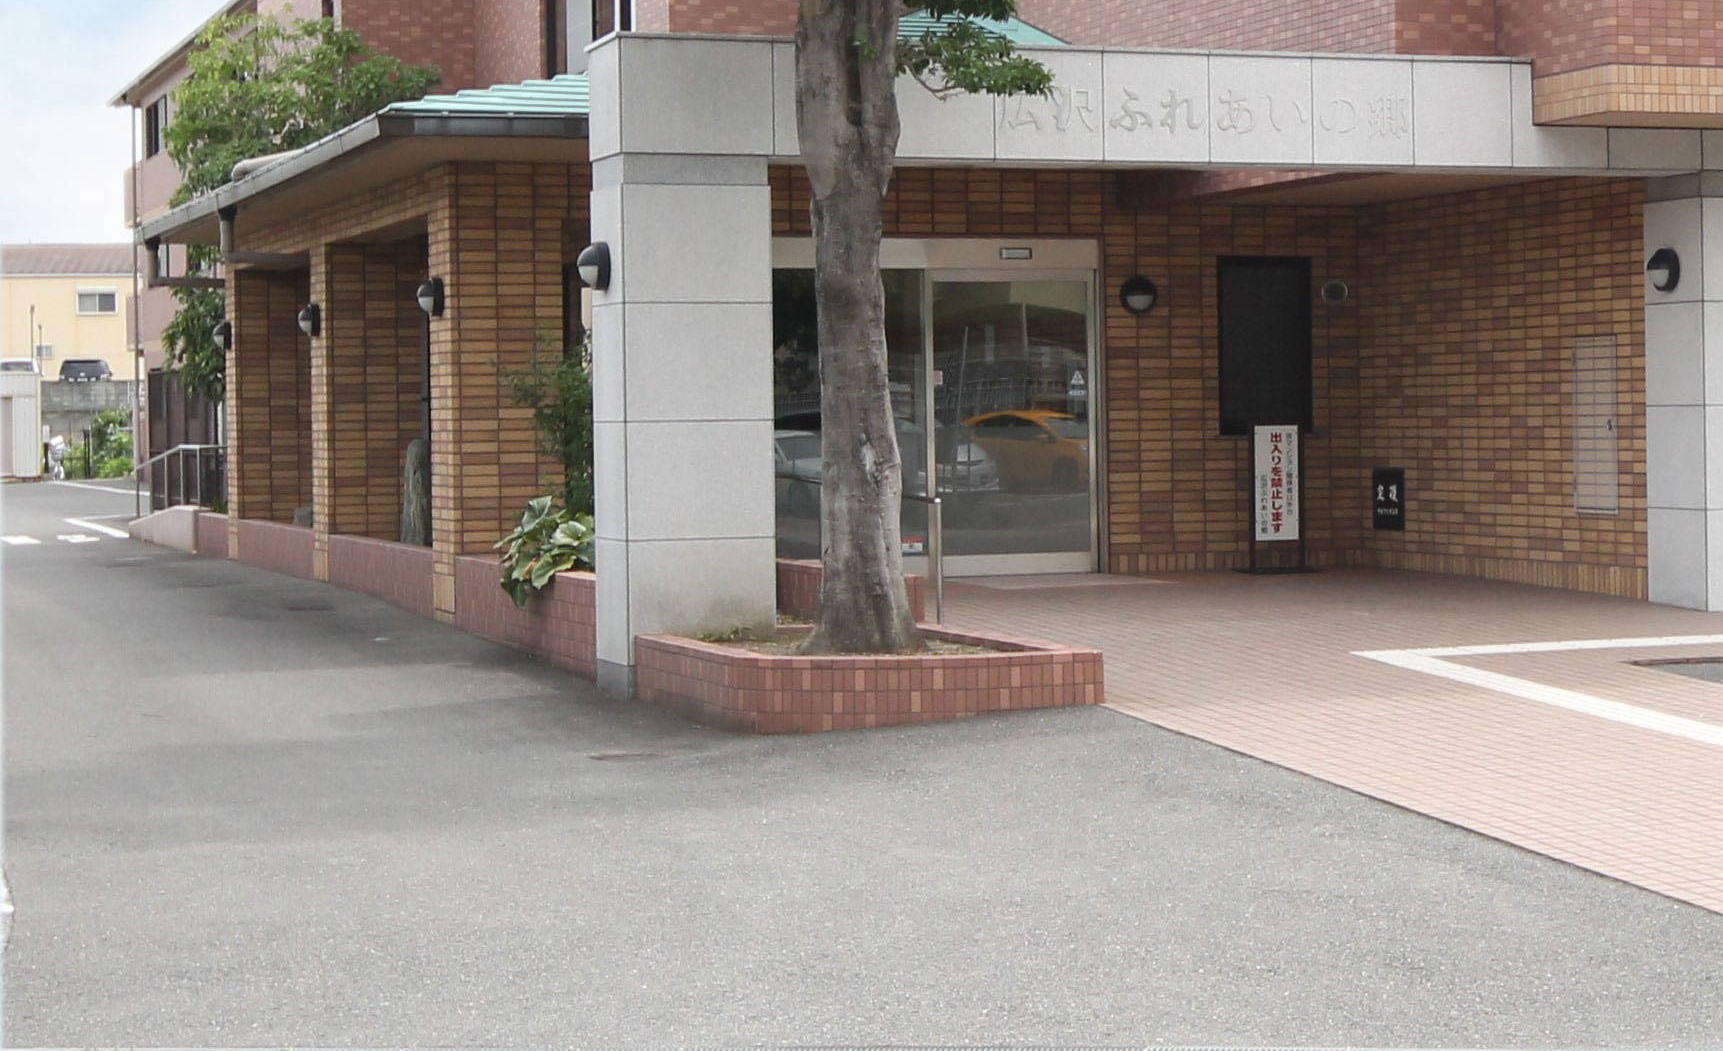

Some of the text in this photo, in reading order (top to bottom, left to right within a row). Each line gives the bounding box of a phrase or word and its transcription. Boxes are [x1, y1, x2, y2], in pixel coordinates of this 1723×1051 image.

[1270, 432, 1283, 533] 出入りを禁止します
